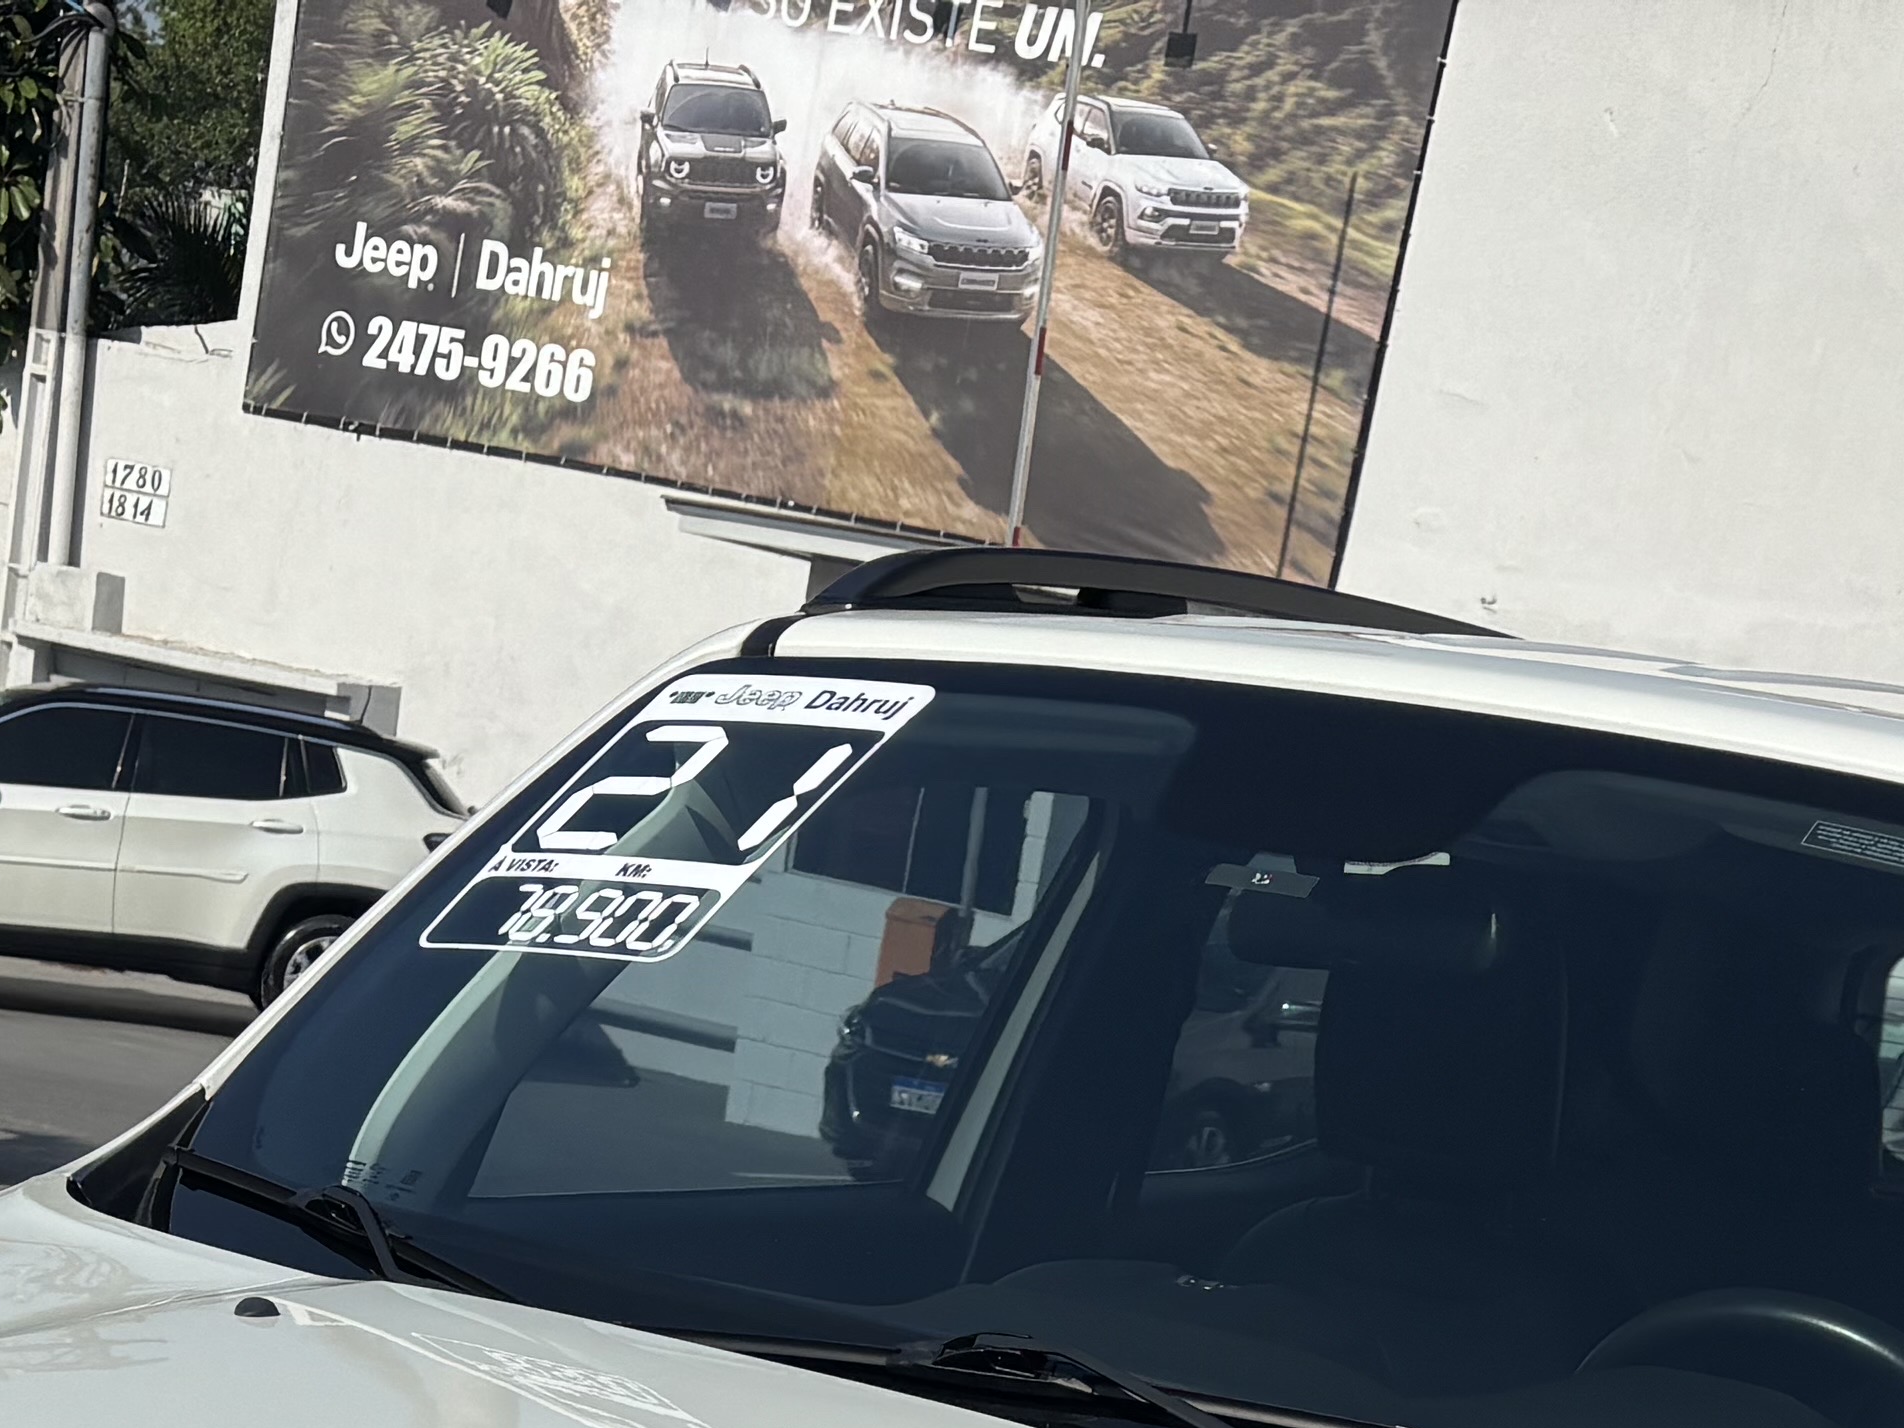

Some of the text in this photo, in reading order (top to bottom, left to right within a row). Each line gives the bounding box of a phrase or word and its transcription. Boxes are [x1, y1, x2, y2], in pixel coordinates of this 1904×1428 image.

[827, 0, 1003, 53] EXISTE
[335, 221, 611, 320] Jeep Dahruj
[362, 315, 596, 403] 2475-9266
[111, 461, 163, 494] 1780
[714, 684, 803, 711] Jeep
[803, 689, 915, 720] Dahruj
[536, 725, 853, 852] 21
